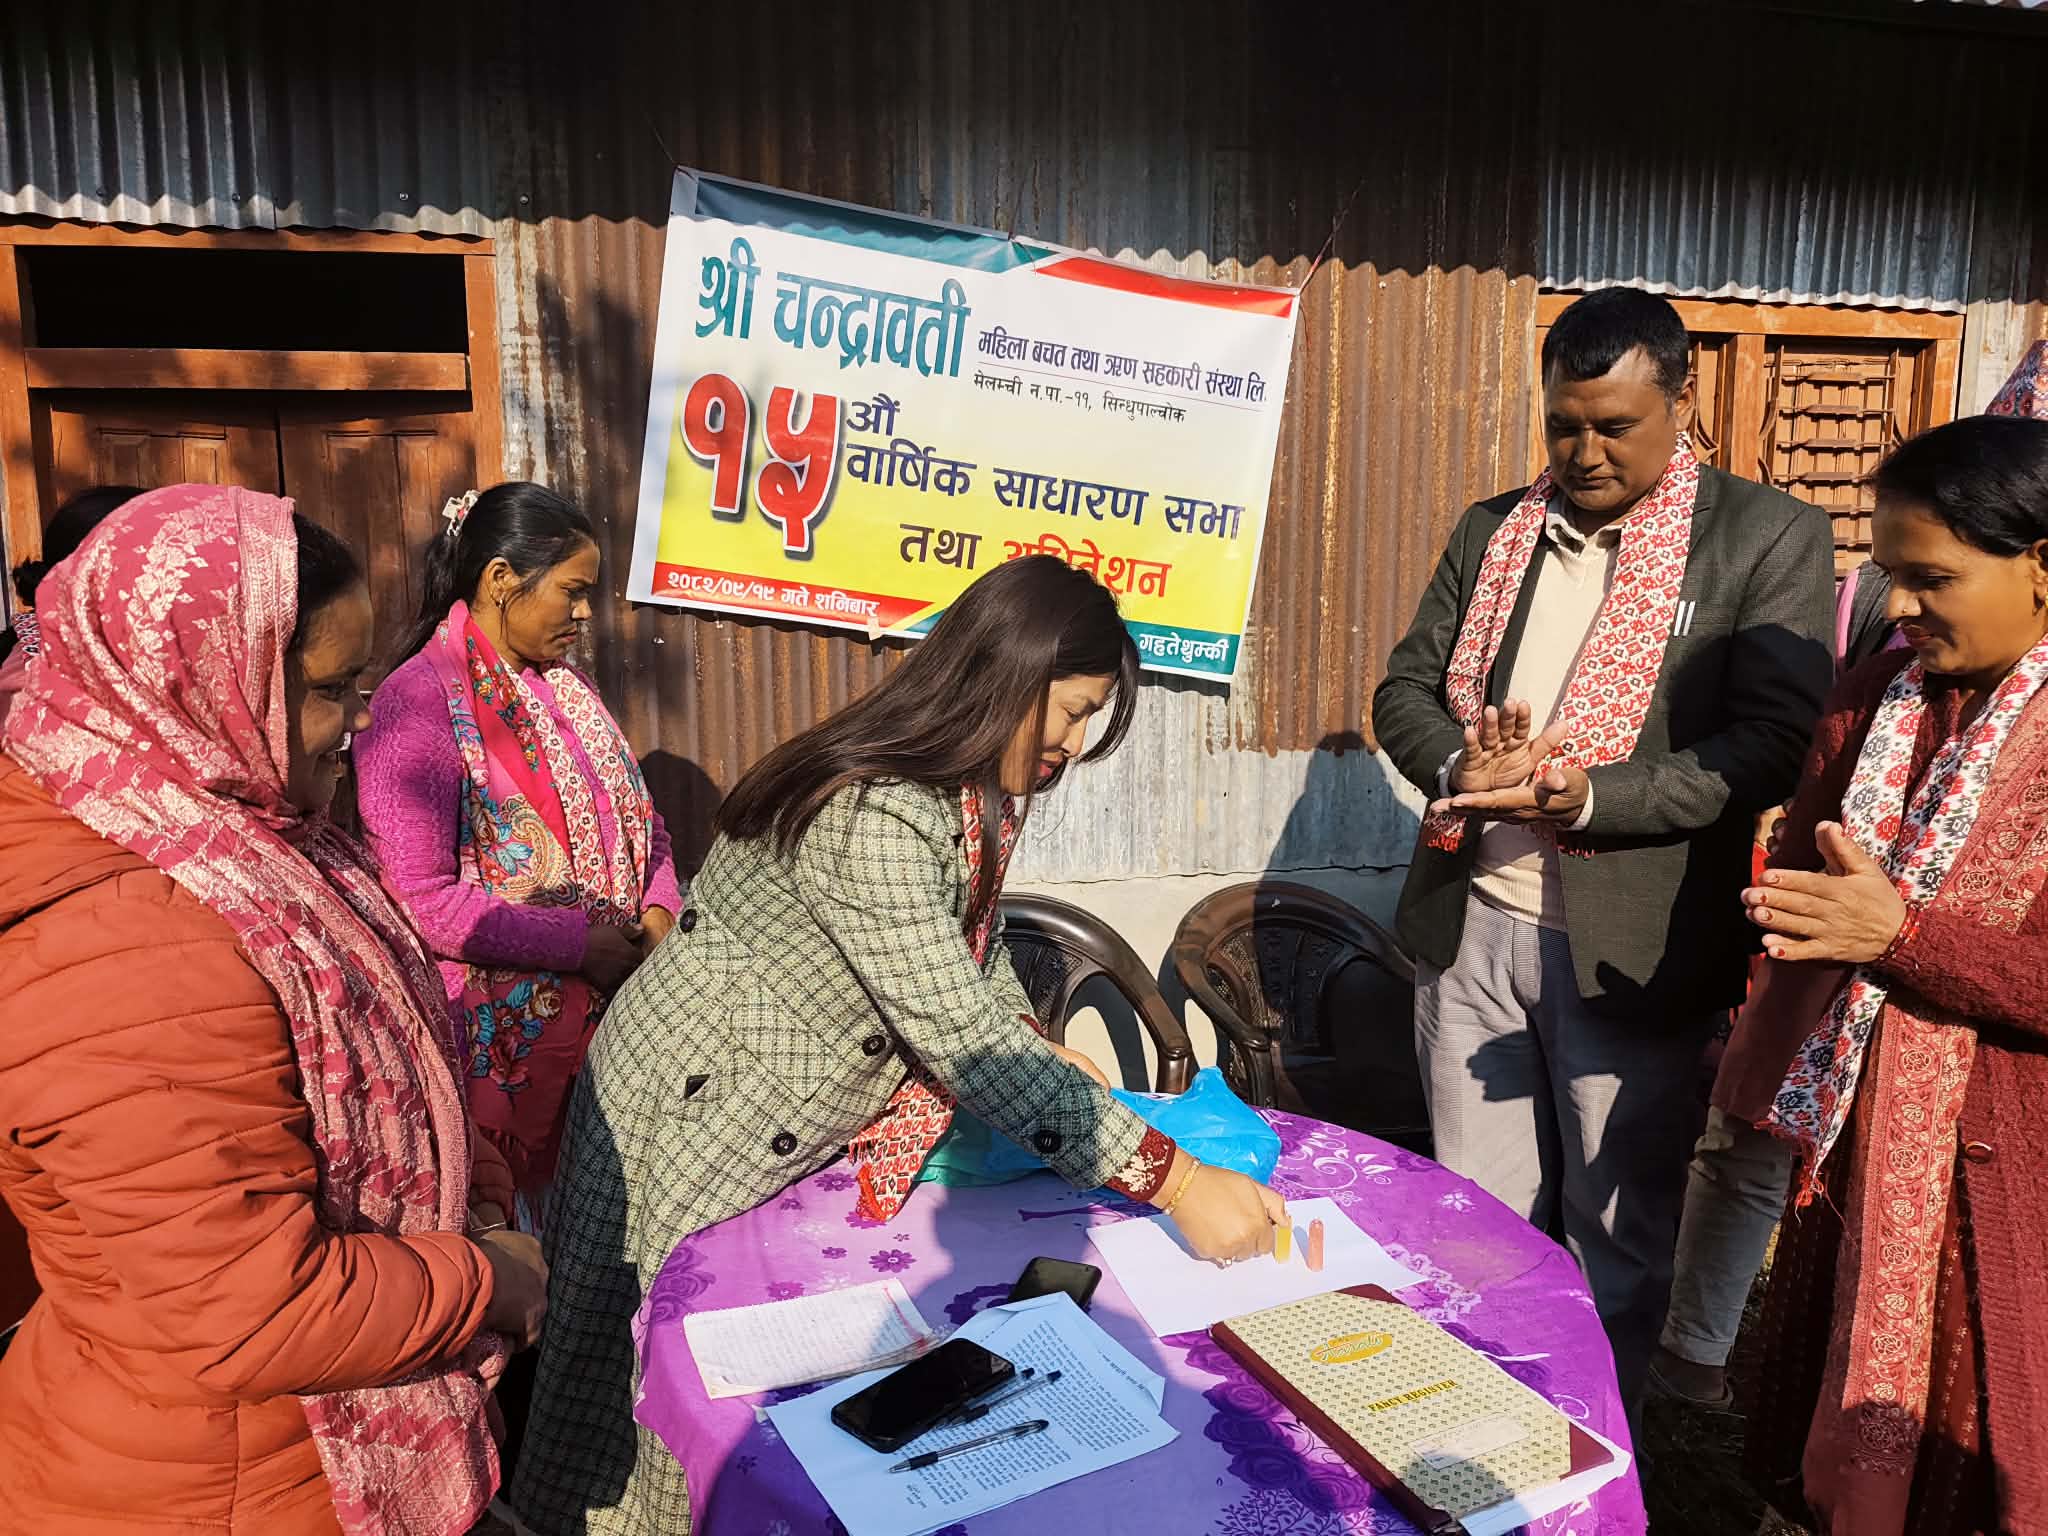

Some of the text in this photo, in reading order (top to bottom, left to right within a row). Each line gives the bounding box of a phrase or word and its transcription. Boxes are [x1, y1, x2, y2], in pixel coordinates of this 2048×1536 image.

[696, 236, 971, 377] श्री चन्द्रावती
[973, 369, 1023, 395] मेलम्ची
[1103, 390, 1186, 422] सिन्धुपाल्चोक
[978, 326, 1267, 402] महिला बचत तथा ऋण सहकारी संस्था लि.
[681, 373, 901, 552] १५ औं
[846, 438, 1246, 540] वार्षिक साधारण सभा
[900, 523, 982, 569] तथा
[781, 586, 810, 608] गते
[1368, 1379, 1458, 1412] FANCY REGISTER
